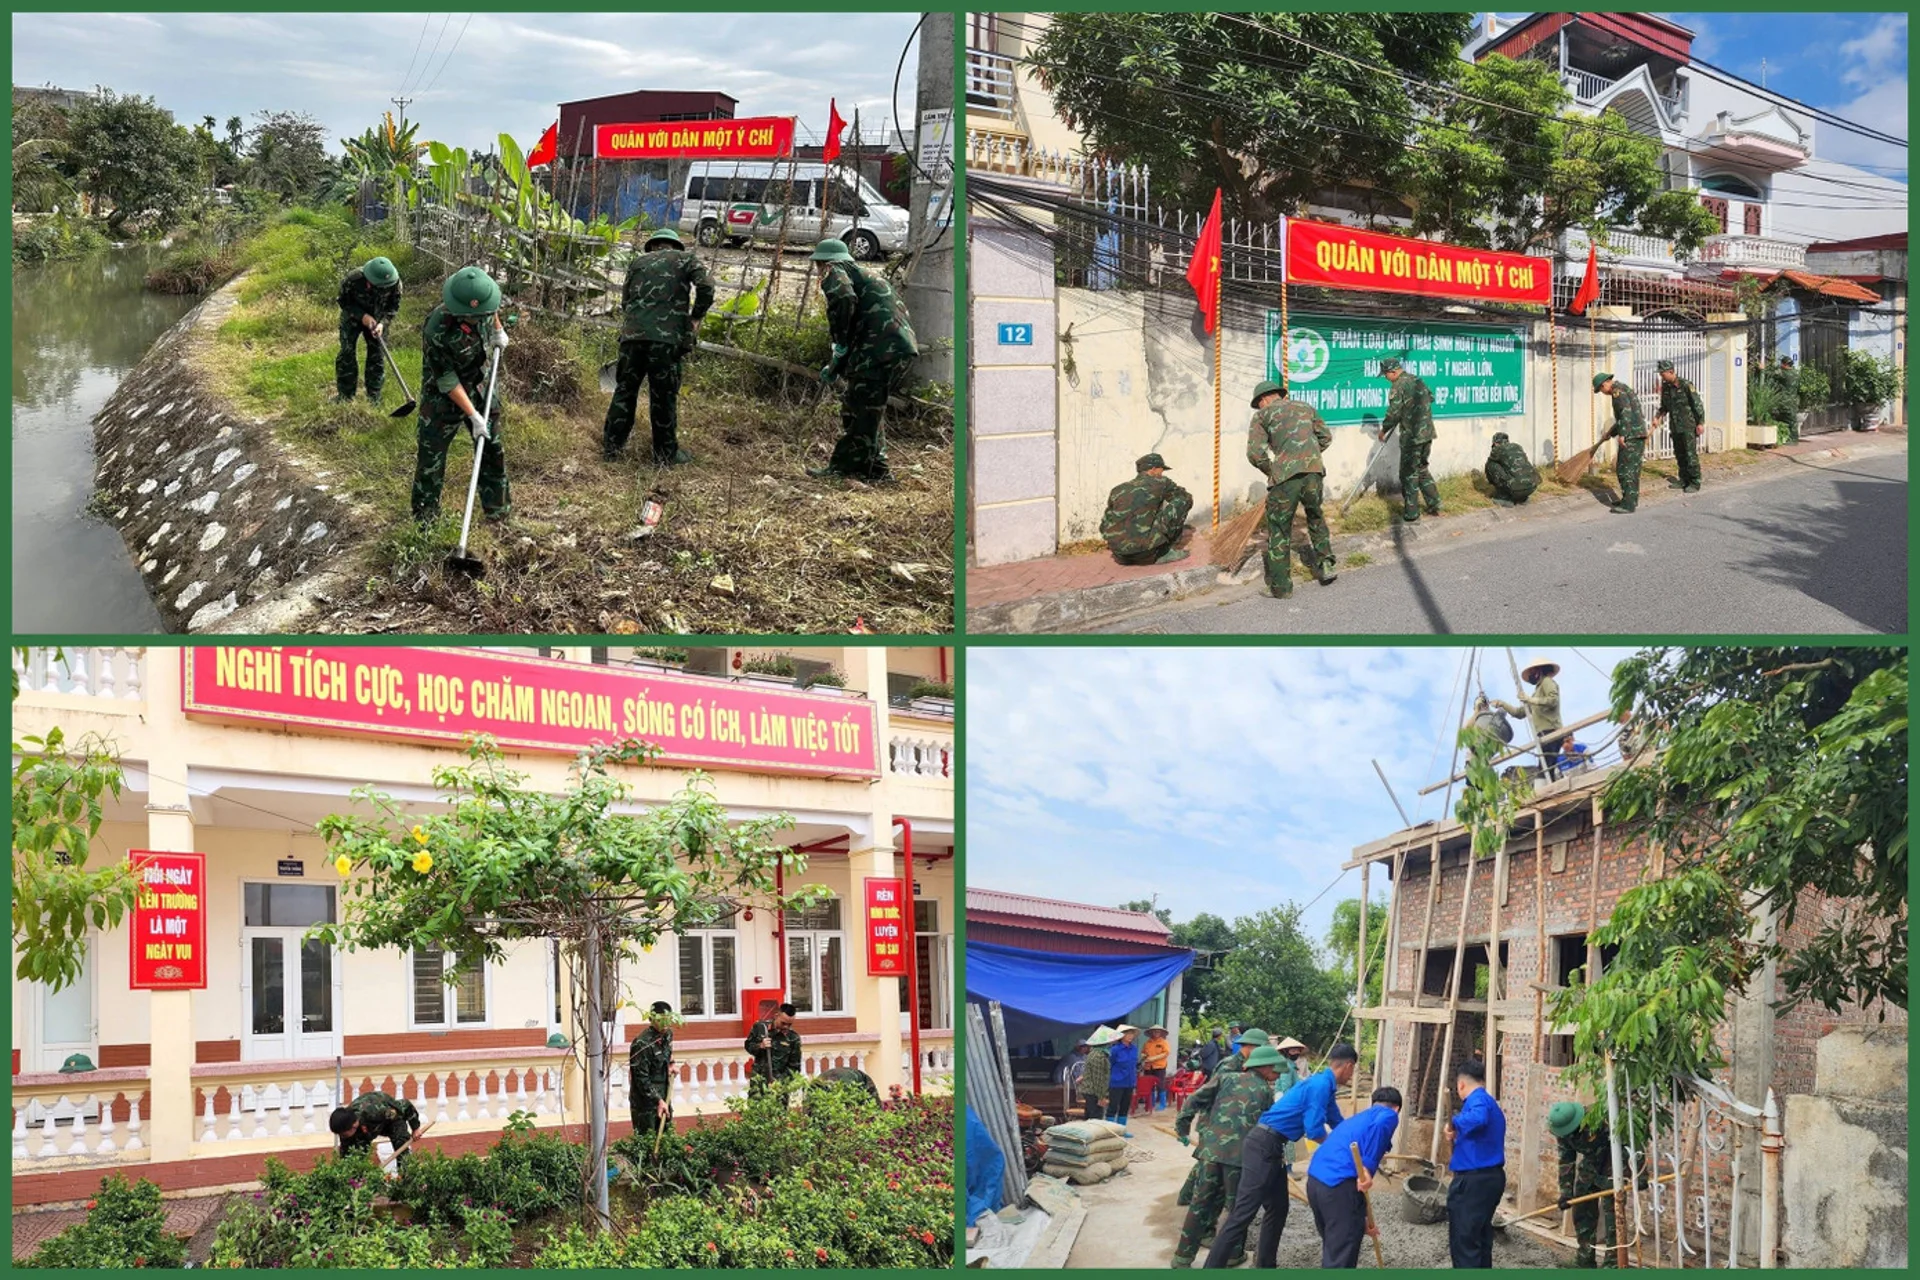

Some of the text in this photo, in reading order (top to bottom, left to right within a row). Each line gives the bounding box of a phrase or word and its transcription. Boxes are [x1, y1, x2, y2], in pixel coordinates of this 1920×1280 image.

[612, 125, 774, 150] QUÂN VỚI DÂN MỘT Ý CHÍ
[1316, 240, 1534, 290] QUÂN VỚI DÂN MỘT Ý CHÍ
[1005, 327, 1026, 341] 12
[1363, 332, 1384, 352] LOẠI
[1420, 354, 1437, 376] NHỎ
[1452, 358, 1476, 376] NGHĨA
[216, 646, 860, 757] NGHĨ TÍCH CỰC, HỌC CHĂM NGOAN, SỐNG CÓ ÍCH, LÀM VIỆC TỐT
[166, 866, 192, 885] NGÀY
[150, 914, 188, 938] LÀ MỘT
[146, 940, 192, 960] NGÀY VUI
